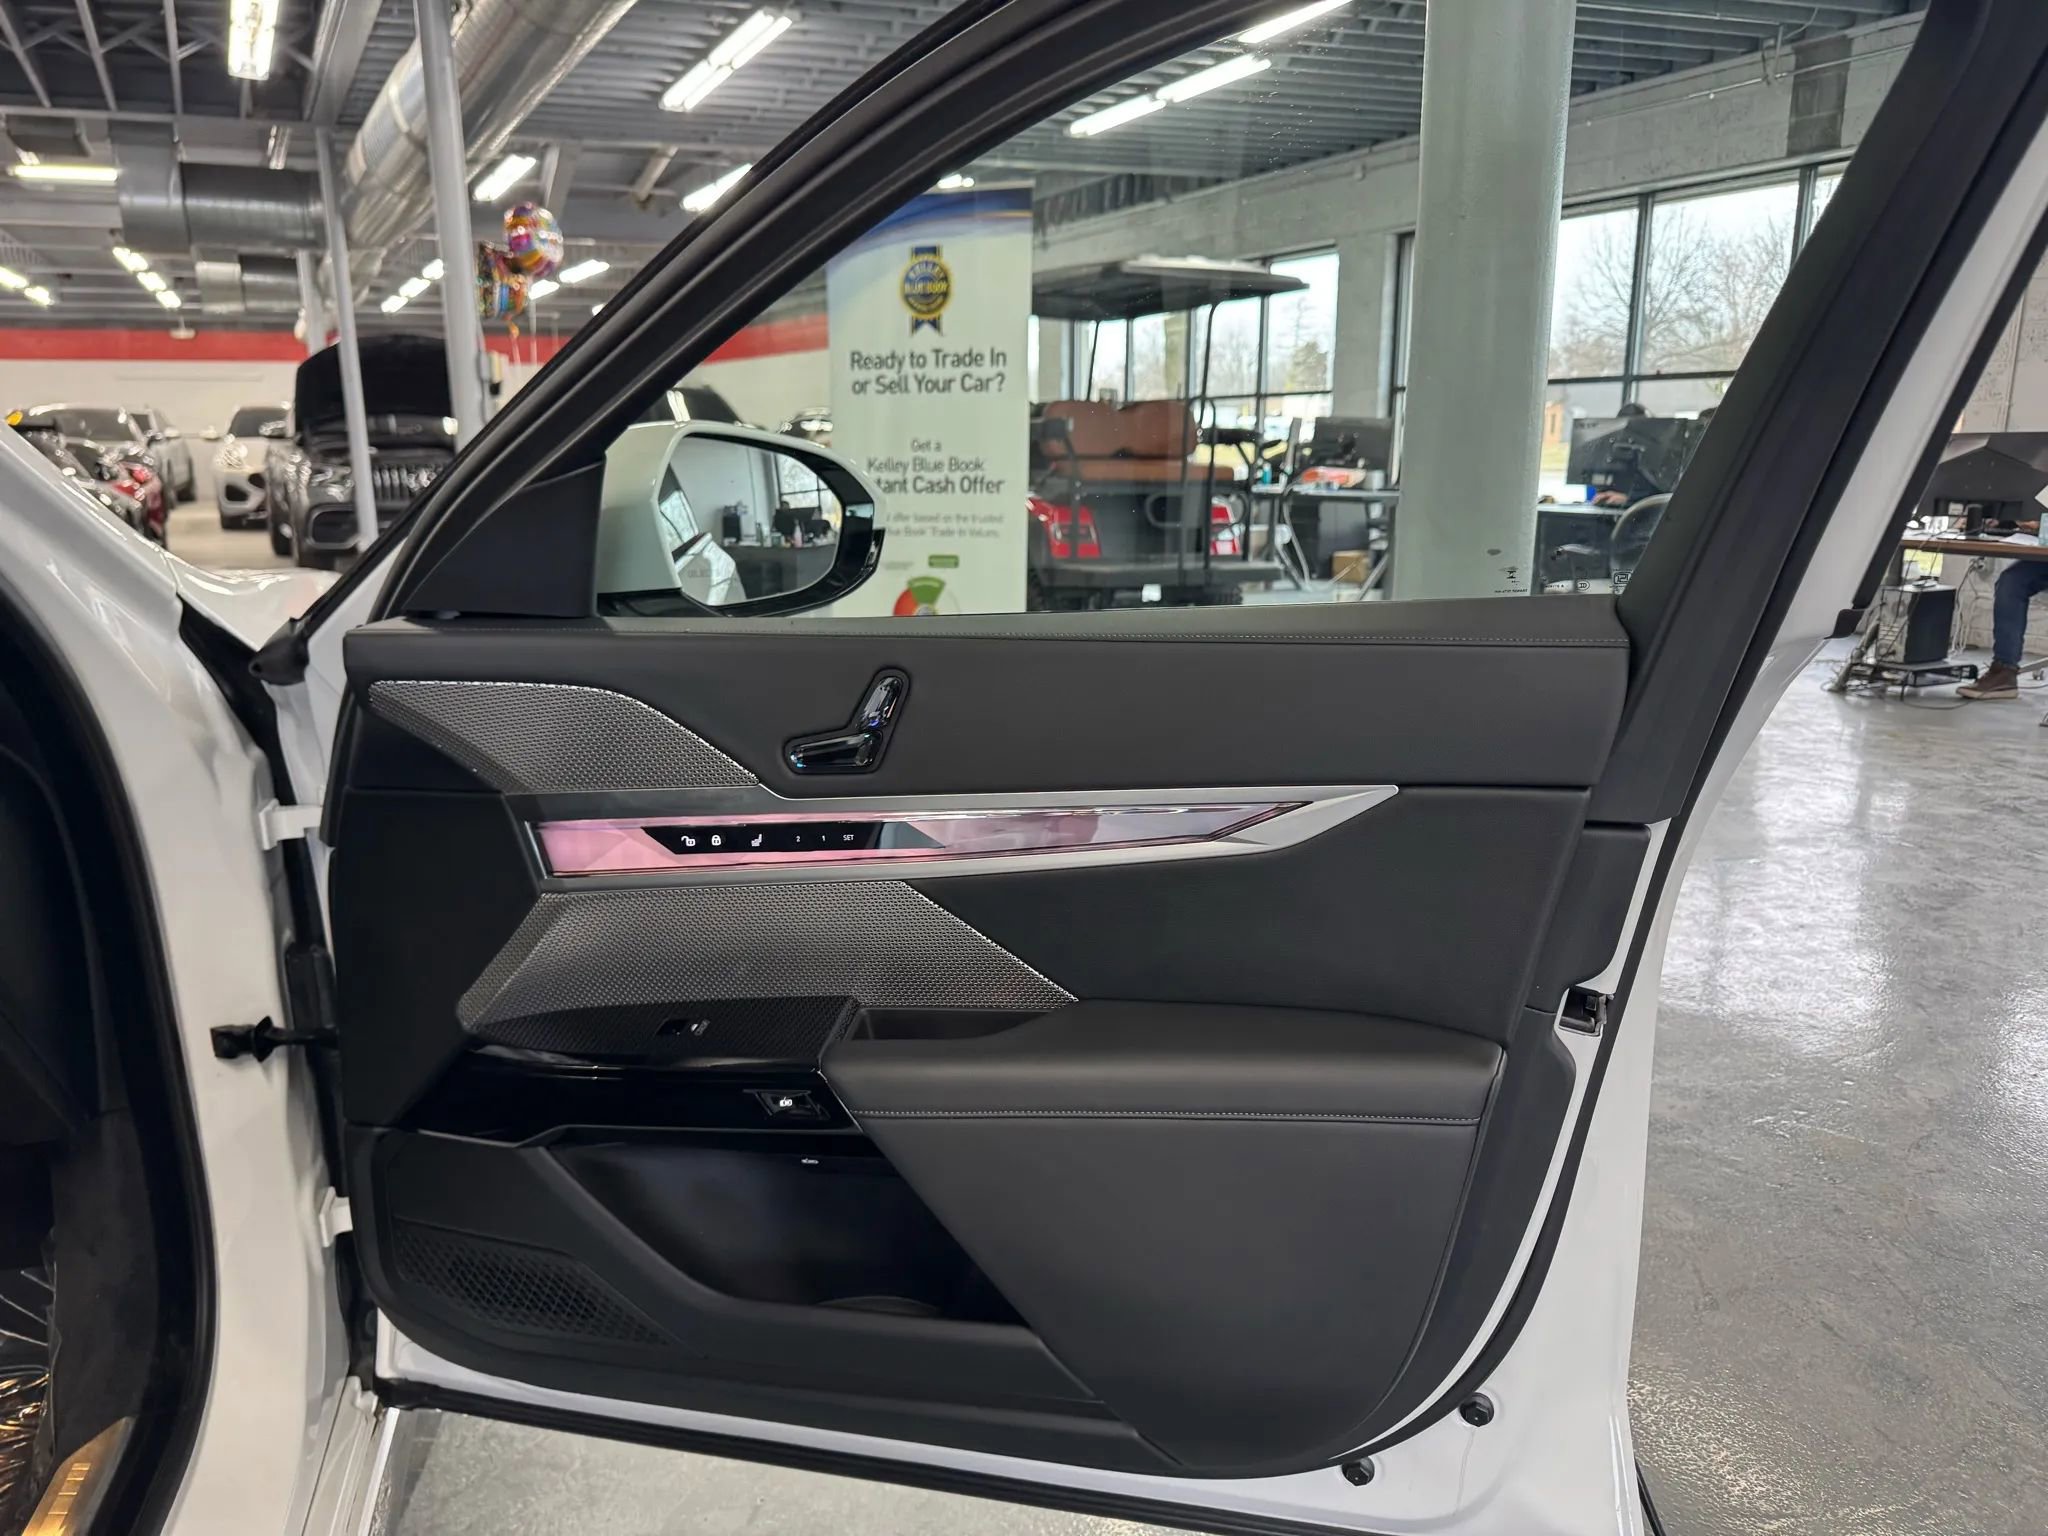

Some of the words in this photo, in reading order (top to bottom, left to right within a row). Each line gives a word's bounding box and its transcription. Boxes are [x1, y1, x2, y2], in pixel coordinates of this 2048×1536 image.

[850, 350, 905, 374] Ready
[910, 351, 927, 369] to
[932, 348, 985, 369] Trade
[990, 347, 1007, 367] In
[852, 379, 870, 395] or
[875, 375, 909, 394] Sell
[913, 374, 955, 393] Your
[960, 373, 1006, 393] Car?
[910, 438, 932, 453] Get
[934, 441, 942, 451] a
[867, 456, 910, 474] Kelley
[912, 457, 945, 473] Blue
[949, 456, 986, 472] Book
[875, 477, 908, 494] tant
[912, 476, 956, 494] Cash
[960, 475, 1005, 494] Offer
[796, 835, 801, 843] 2
